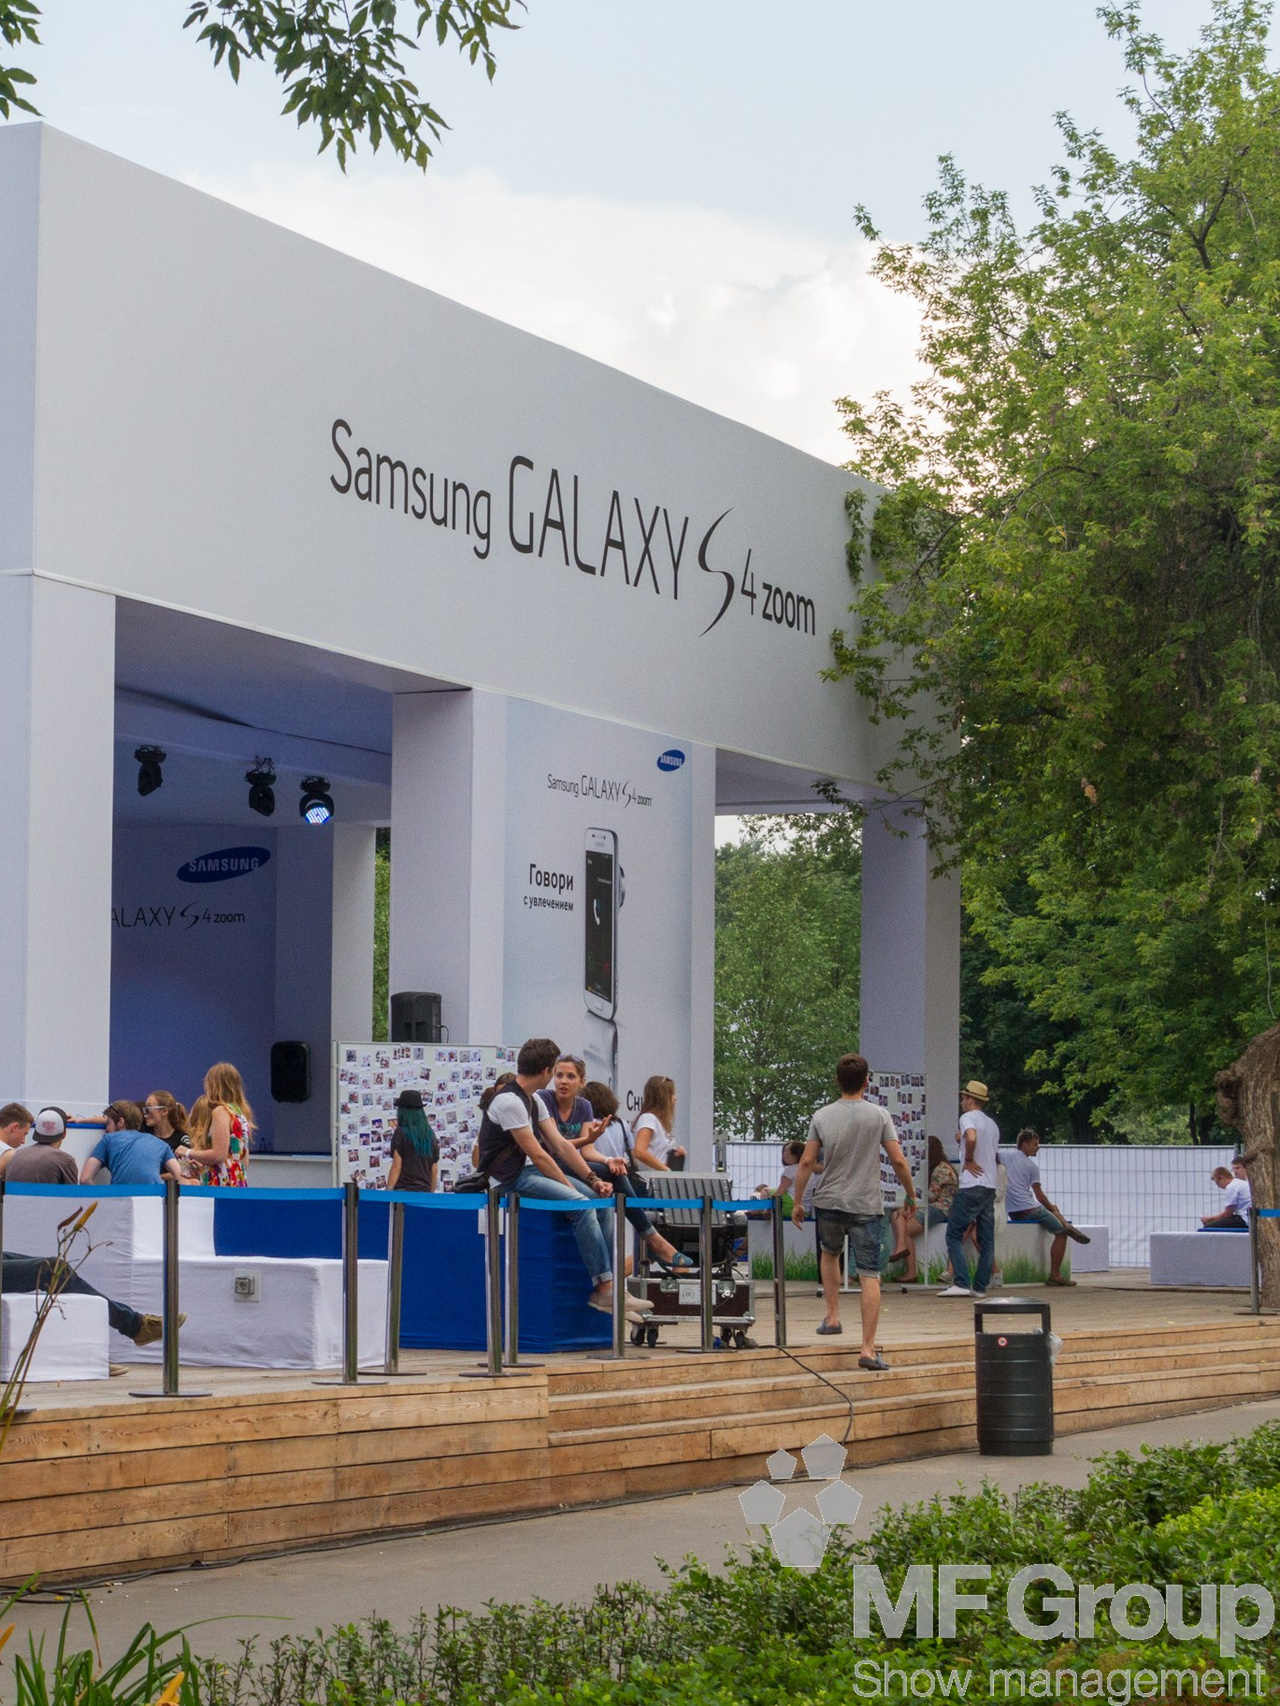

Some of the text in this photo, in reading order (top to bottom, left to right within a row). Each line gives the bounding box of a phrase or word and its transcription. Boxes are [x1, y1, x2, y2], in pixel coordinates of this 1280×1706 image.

[329, 418, 492, 560] Samsung
[508, 455, 689, 600] GALAXY
[761, 582, 816, 636] zoom
[660, 754, 683, 767] SAMSUNG
[547, 773, 579, 798] Samsung
[581, 775, 621, 802] GALAXY
[637, 794, 652, 807] zoom
[188, 857, 260, 873] SAMSUNG
[529, 863, 574, 895] Говори
[528, 895, 574, 912] увлечением
[111, 906, 176, 928] ALAXY
[214, 912, 245, 924] zoom
